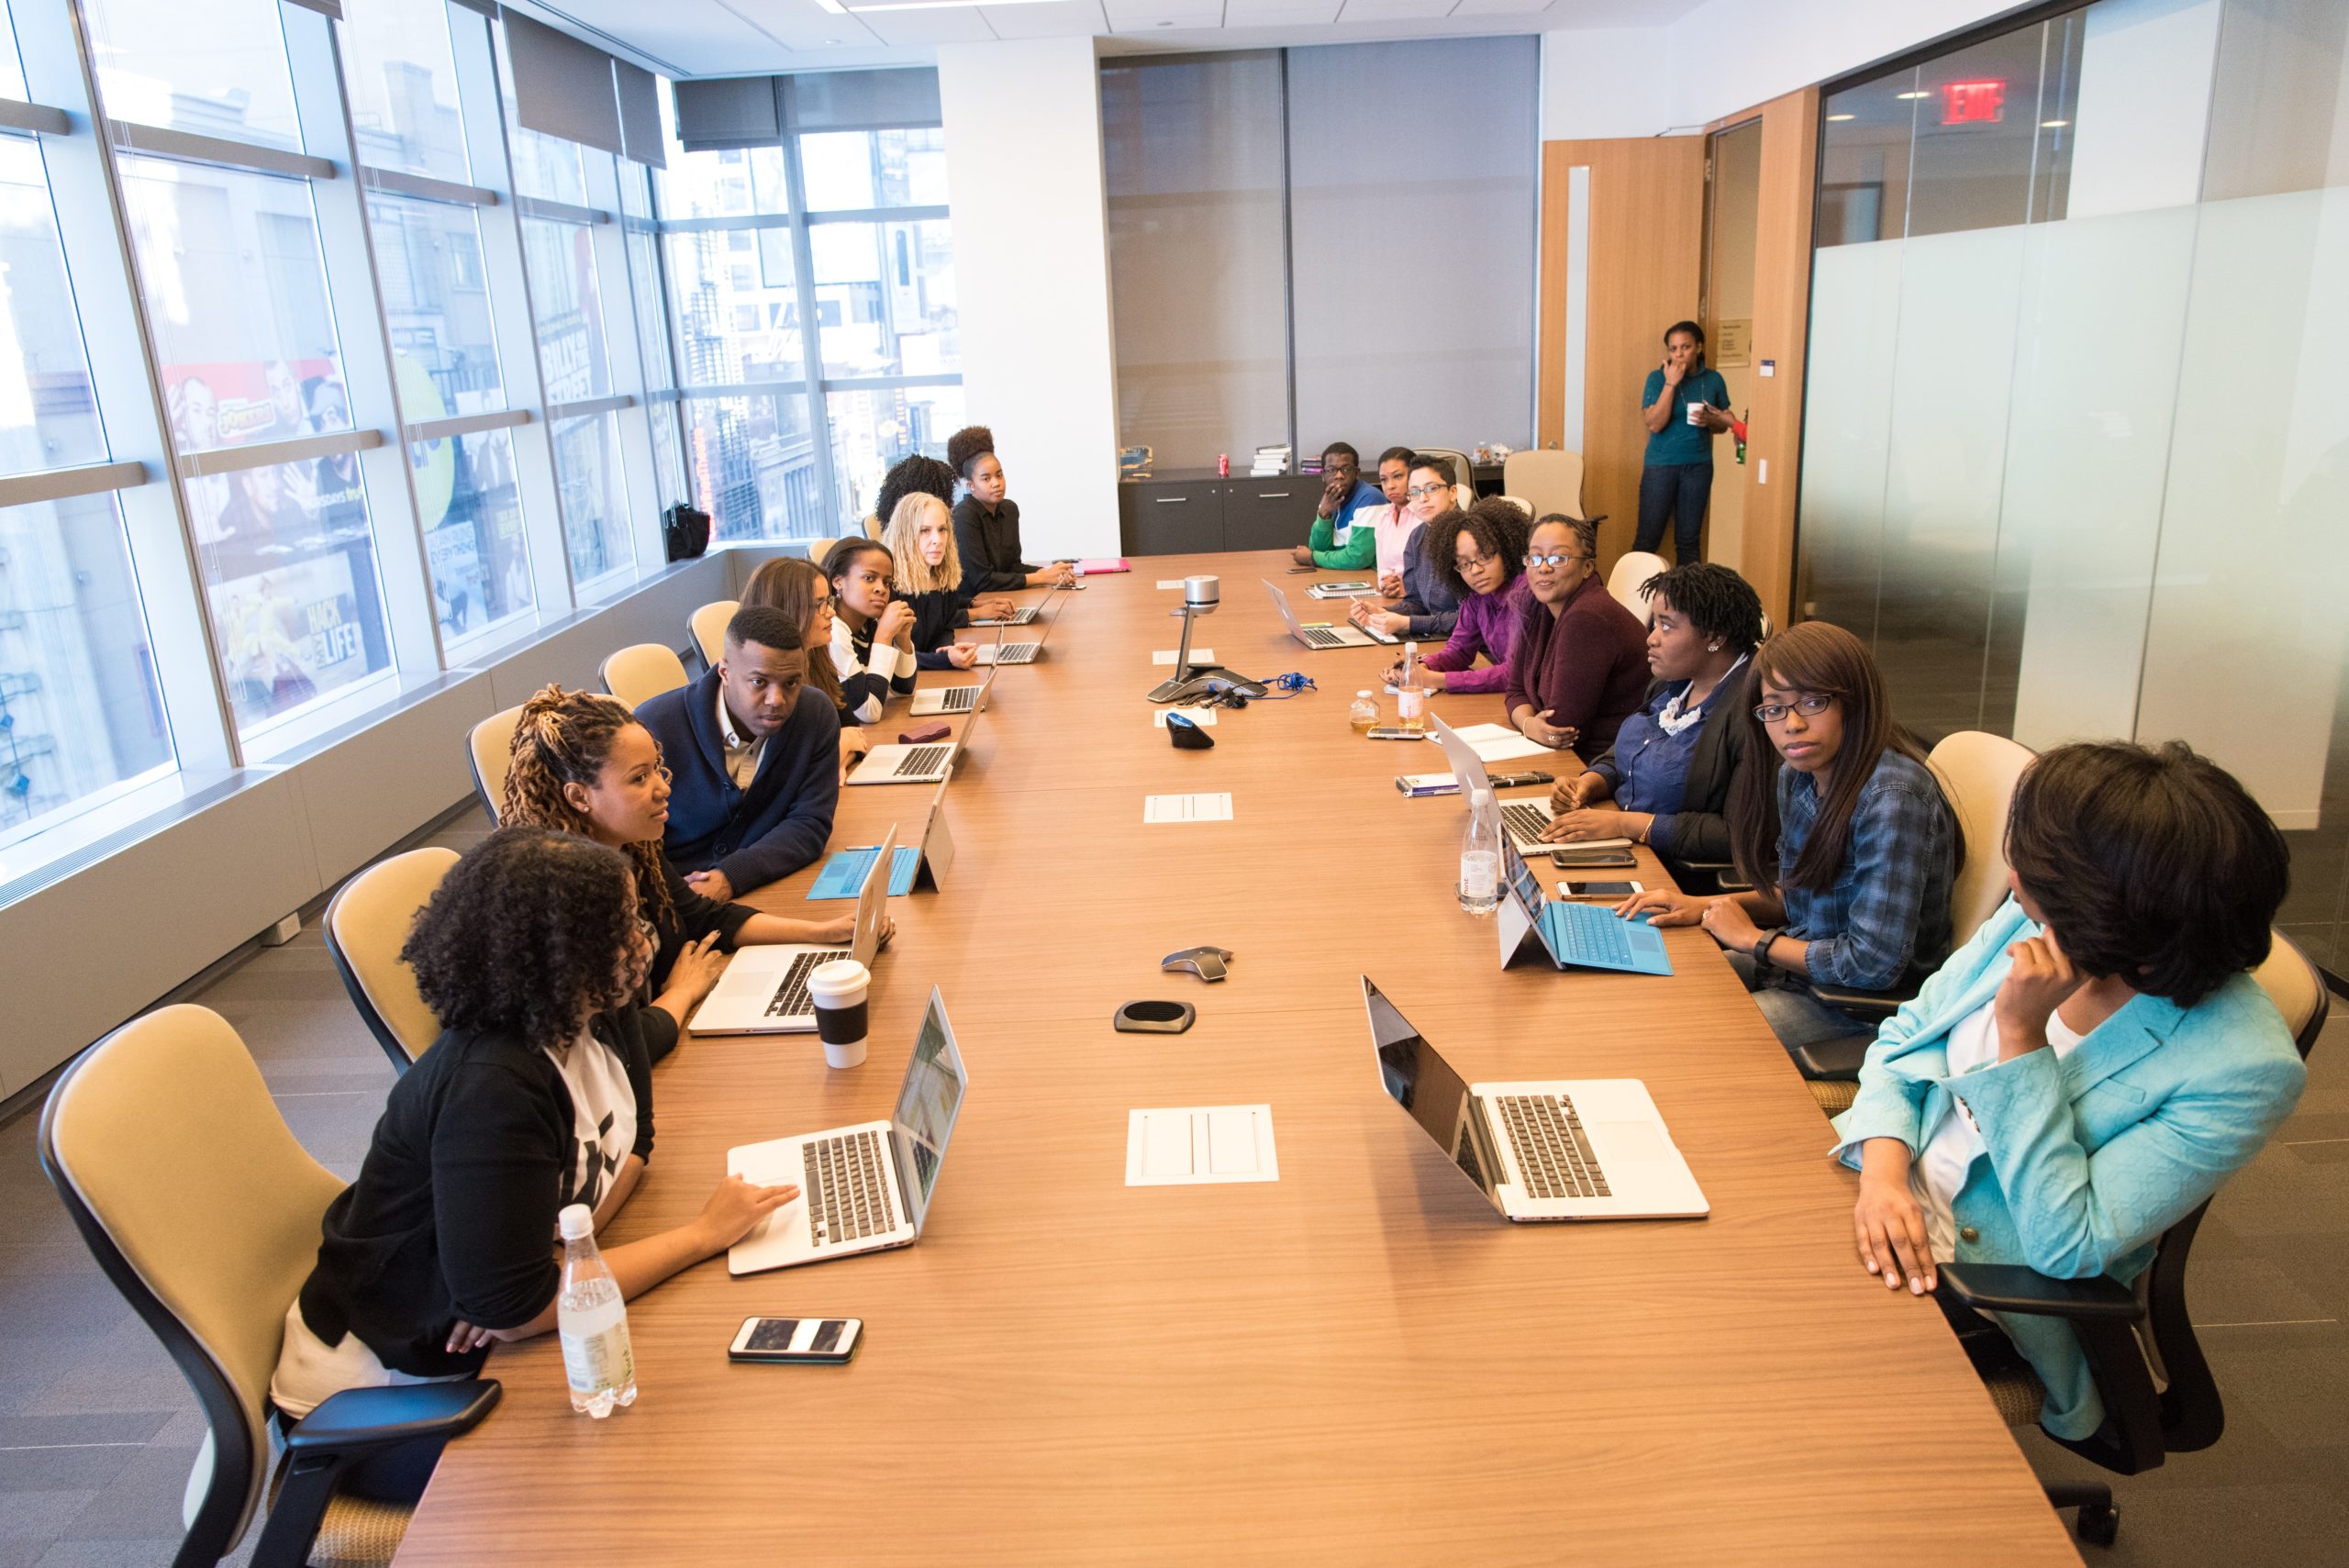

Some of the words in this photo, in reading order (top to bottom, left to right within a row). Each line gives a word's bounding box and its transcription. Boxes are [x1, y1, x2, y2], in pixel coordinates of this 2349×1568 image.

[540, 332, 578, 385] BILLY
[306, 596, 341, 636] HACK
[322, 622, 356, 664] LIFE
